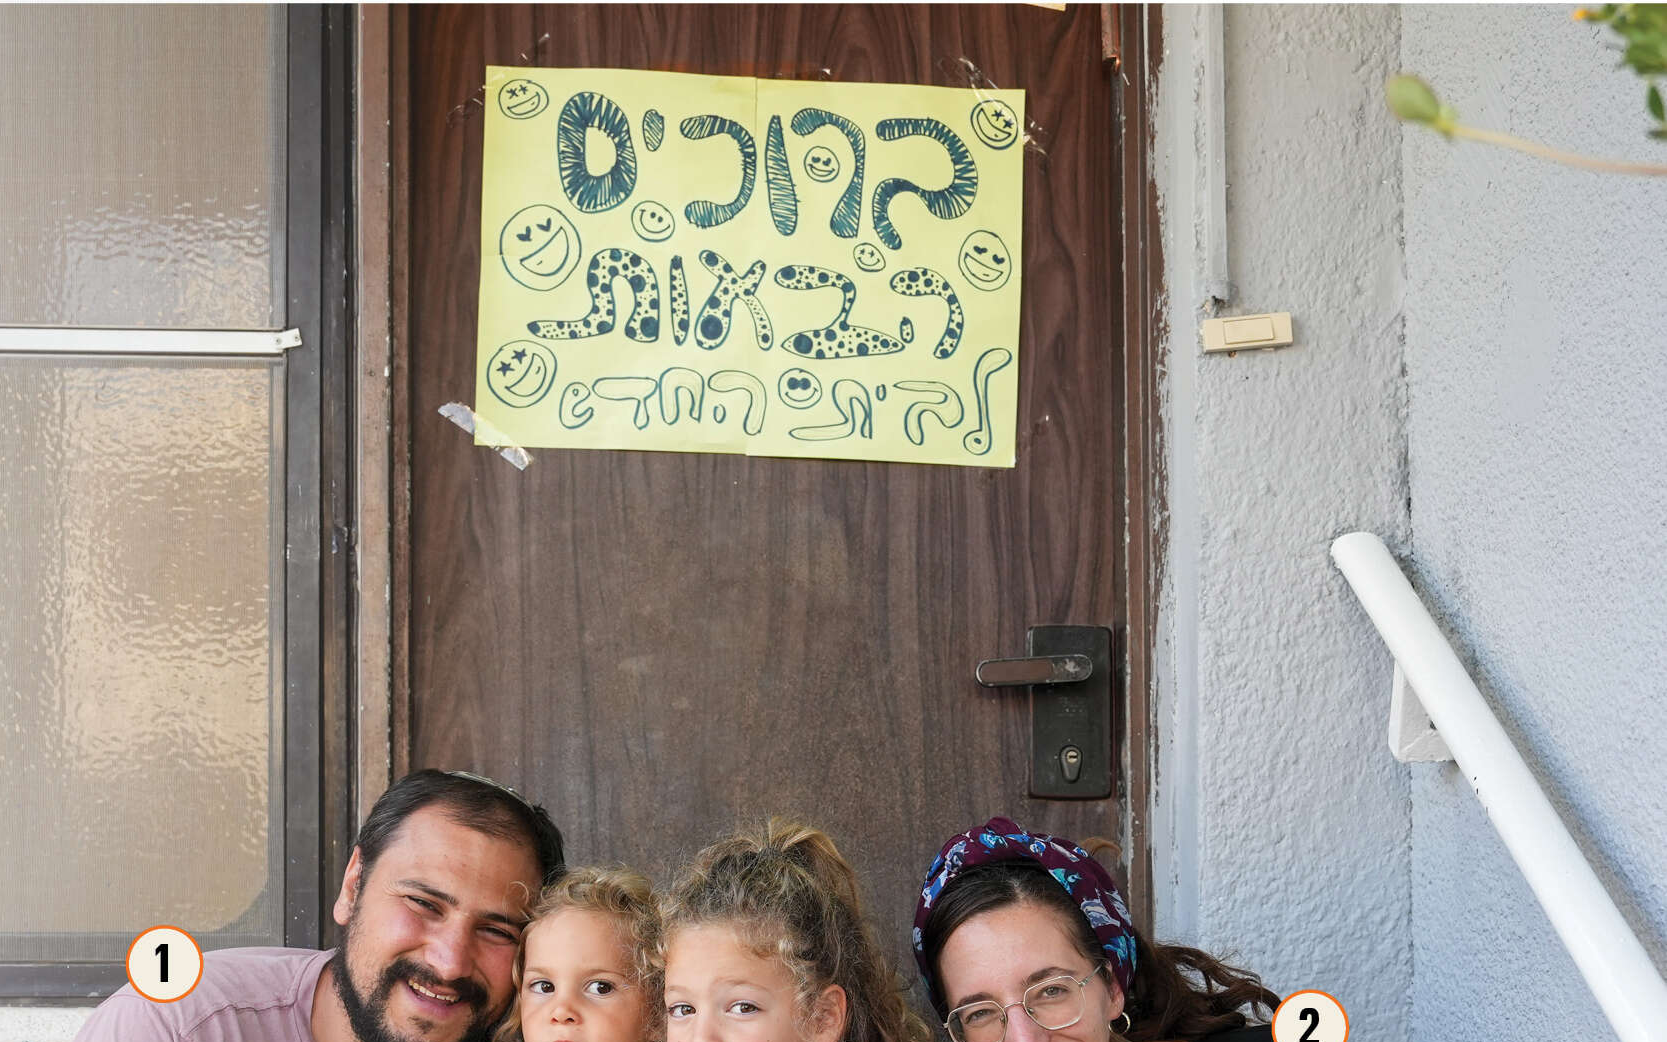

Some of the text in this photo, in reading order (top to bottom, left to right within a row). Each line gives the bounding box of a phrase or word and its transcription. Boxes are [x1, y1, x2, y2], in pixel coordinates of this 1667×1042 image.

[557, 91, 978, 250] ברוכים
[527, 248, 964, 360] הבאות
[559, 348, 1012, 456] לבית החדש
